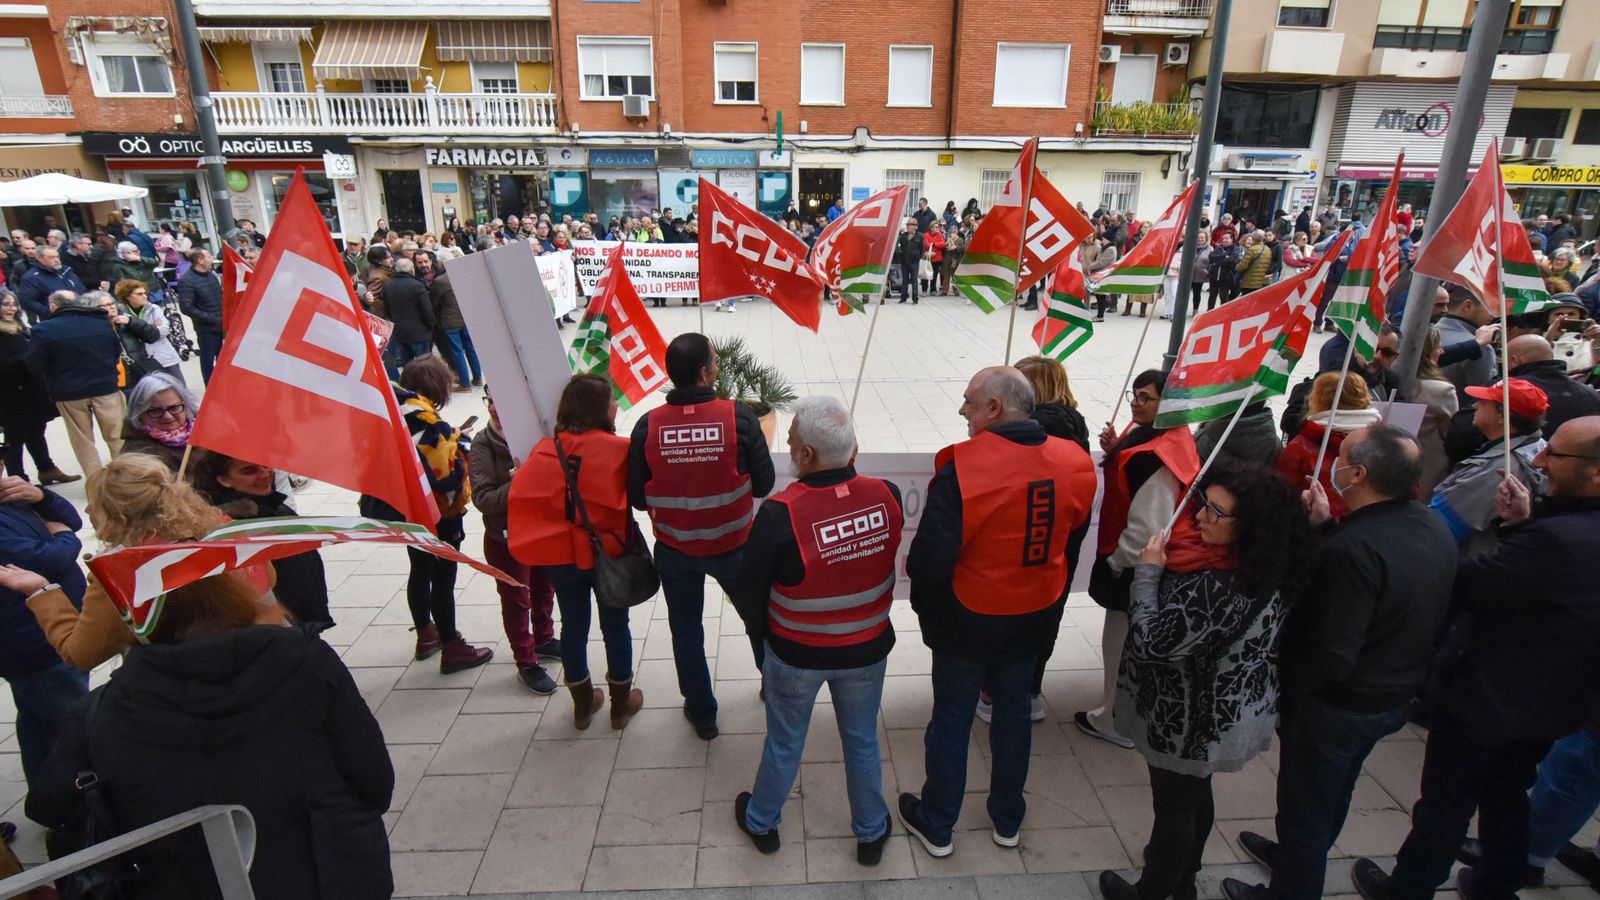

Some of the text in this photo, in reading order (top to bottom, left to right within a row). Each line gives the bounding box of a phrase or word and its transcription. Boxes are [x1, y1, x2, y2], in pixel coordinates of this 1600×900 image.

[159, 140, 205, 153] OPTIC
[221, 137, 313, 153] ARGÜELLES
[425, 148, 540, 166] FARMACIA
[0, 168, 67, 178] ESTAURANTE
[1532, 168, 1583, 182] COMPRO
[1586, 169, 1600, 182] OR
[574, 247, 596, 256] NOS
[636, 249, 682, 258] DEJANDO
[685, 250, 699, 259] MO
[577, 257, 591, 266] OR
[646, 270, 699, 279] TRANSPARE
[665, 280, 699, 292] PERMI
[664, 428, 719, 443] CCOO
[661, 448, 688, 456] sanidad
[694, 446, 724, 454] sectores
[667, 455, 719, 463] sociosanitarios
[820, 511, 884, 544] CCOO
[821, 543, 852, 559] sanidad
[859, 532, 890, 547] sectores
[828, 544, 885, 565] sociosanitarios
